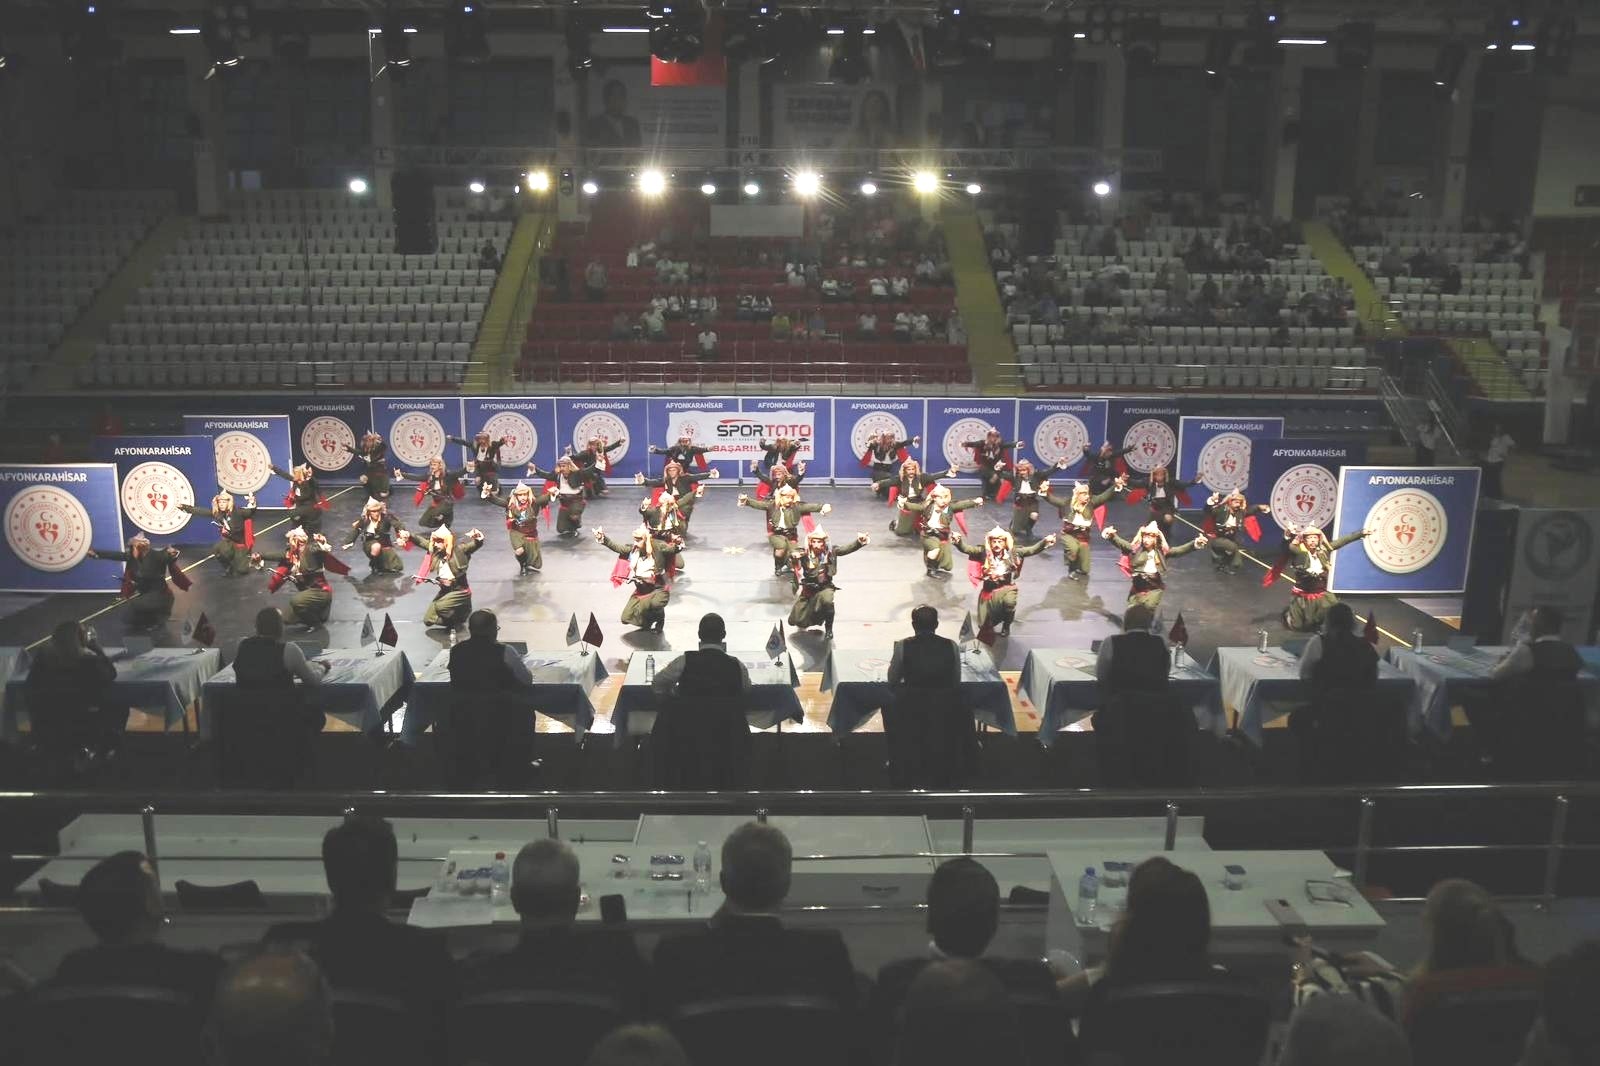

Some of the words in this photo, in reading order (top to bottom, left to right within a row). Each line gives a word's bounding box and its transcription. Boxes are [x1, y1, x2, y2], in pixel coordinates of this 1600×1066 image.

[297, 404, 355, 412] AFYONKARAHİSAR
[387, 402, 444, 411] AFYONKARAHİSAR
[480, 402, 537, 411] AFYONKARAHİSAR
[572, 402, 630, 411] AFYONKARAHİSAR
[665, 402, 723, 410] AFYONKARAHİSAR
[757, 402, 815, 410] AFYONKARAHİSAR
[851, 402, 909, 411] AFYONKARAHİSAR
[1035, 404, 1092, 413] AFYONKARAHİSAR
[944, 407, 1001, 415] AFYONKARAHİSAR
[1123, 407, 1181, 416] AFYONKARAHİSAR
[204, 420, 269, 430] AFYONKARAHİSAR
[1201, 422, 1264, 432] AFYONKARAHİSAR
[114, 446, 191, 457] AFYONKARAHİSAR
[1273, 448, 1347, 458] AFYONKARAHİSAR
[0, 472, 87, 483] AFYONKARAHİSAR
[1369, 475, 1455, 487] AFYONKARAHİSAR
